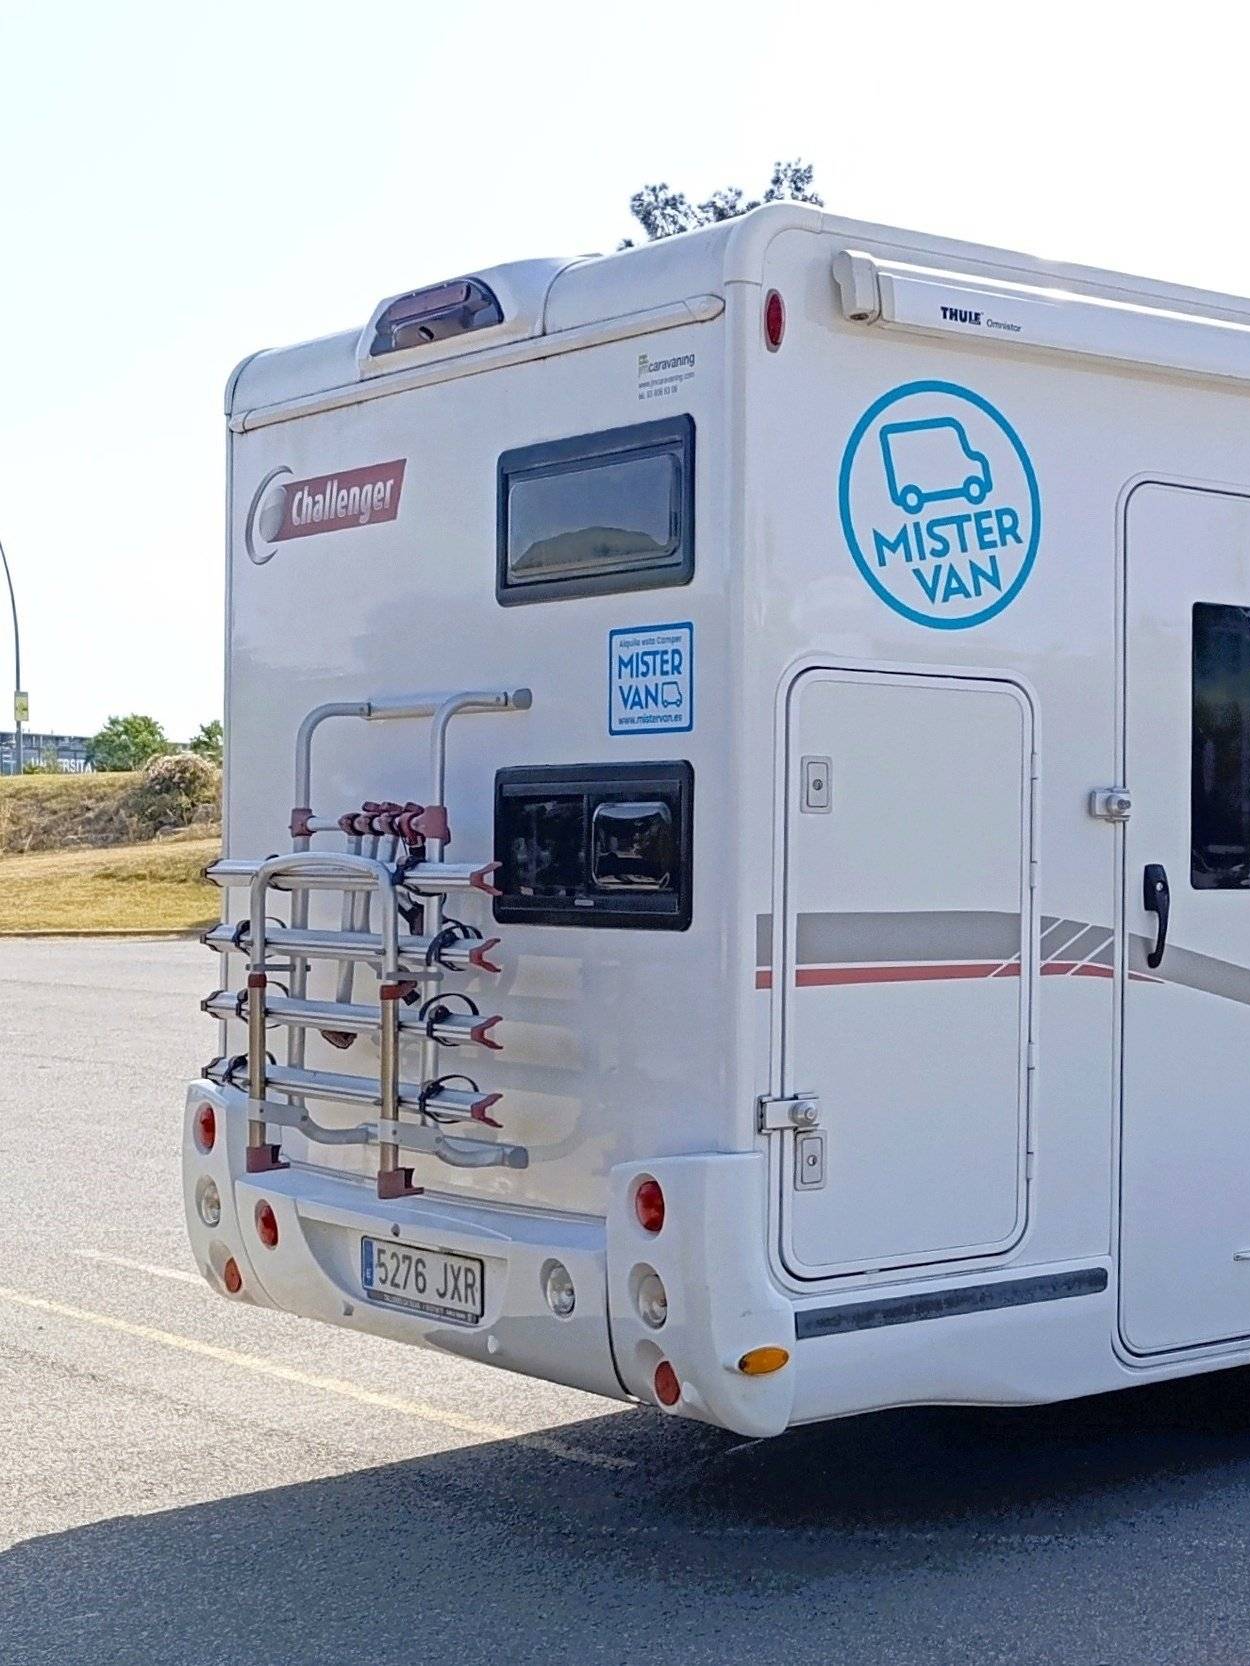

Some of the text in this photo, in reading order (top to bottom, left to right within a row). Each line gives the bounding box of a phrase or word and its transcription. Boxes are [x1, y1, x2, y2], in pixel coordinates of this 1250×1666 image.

[940, 306, 982, 326] THULE
[291, 478, 395, 526] Challenger
[872, 507, 1023, 567] MISTER
[912, 555, 1002, 605] VAN
[618, 648, 683, 680] MISTER
[618, 682, 659, 710] VAN
[618, 714, 682, 725] www.mistervan.es
[376, 1247, 427, 1294] 5276
[436, 1262, 477, 1307] JXR
